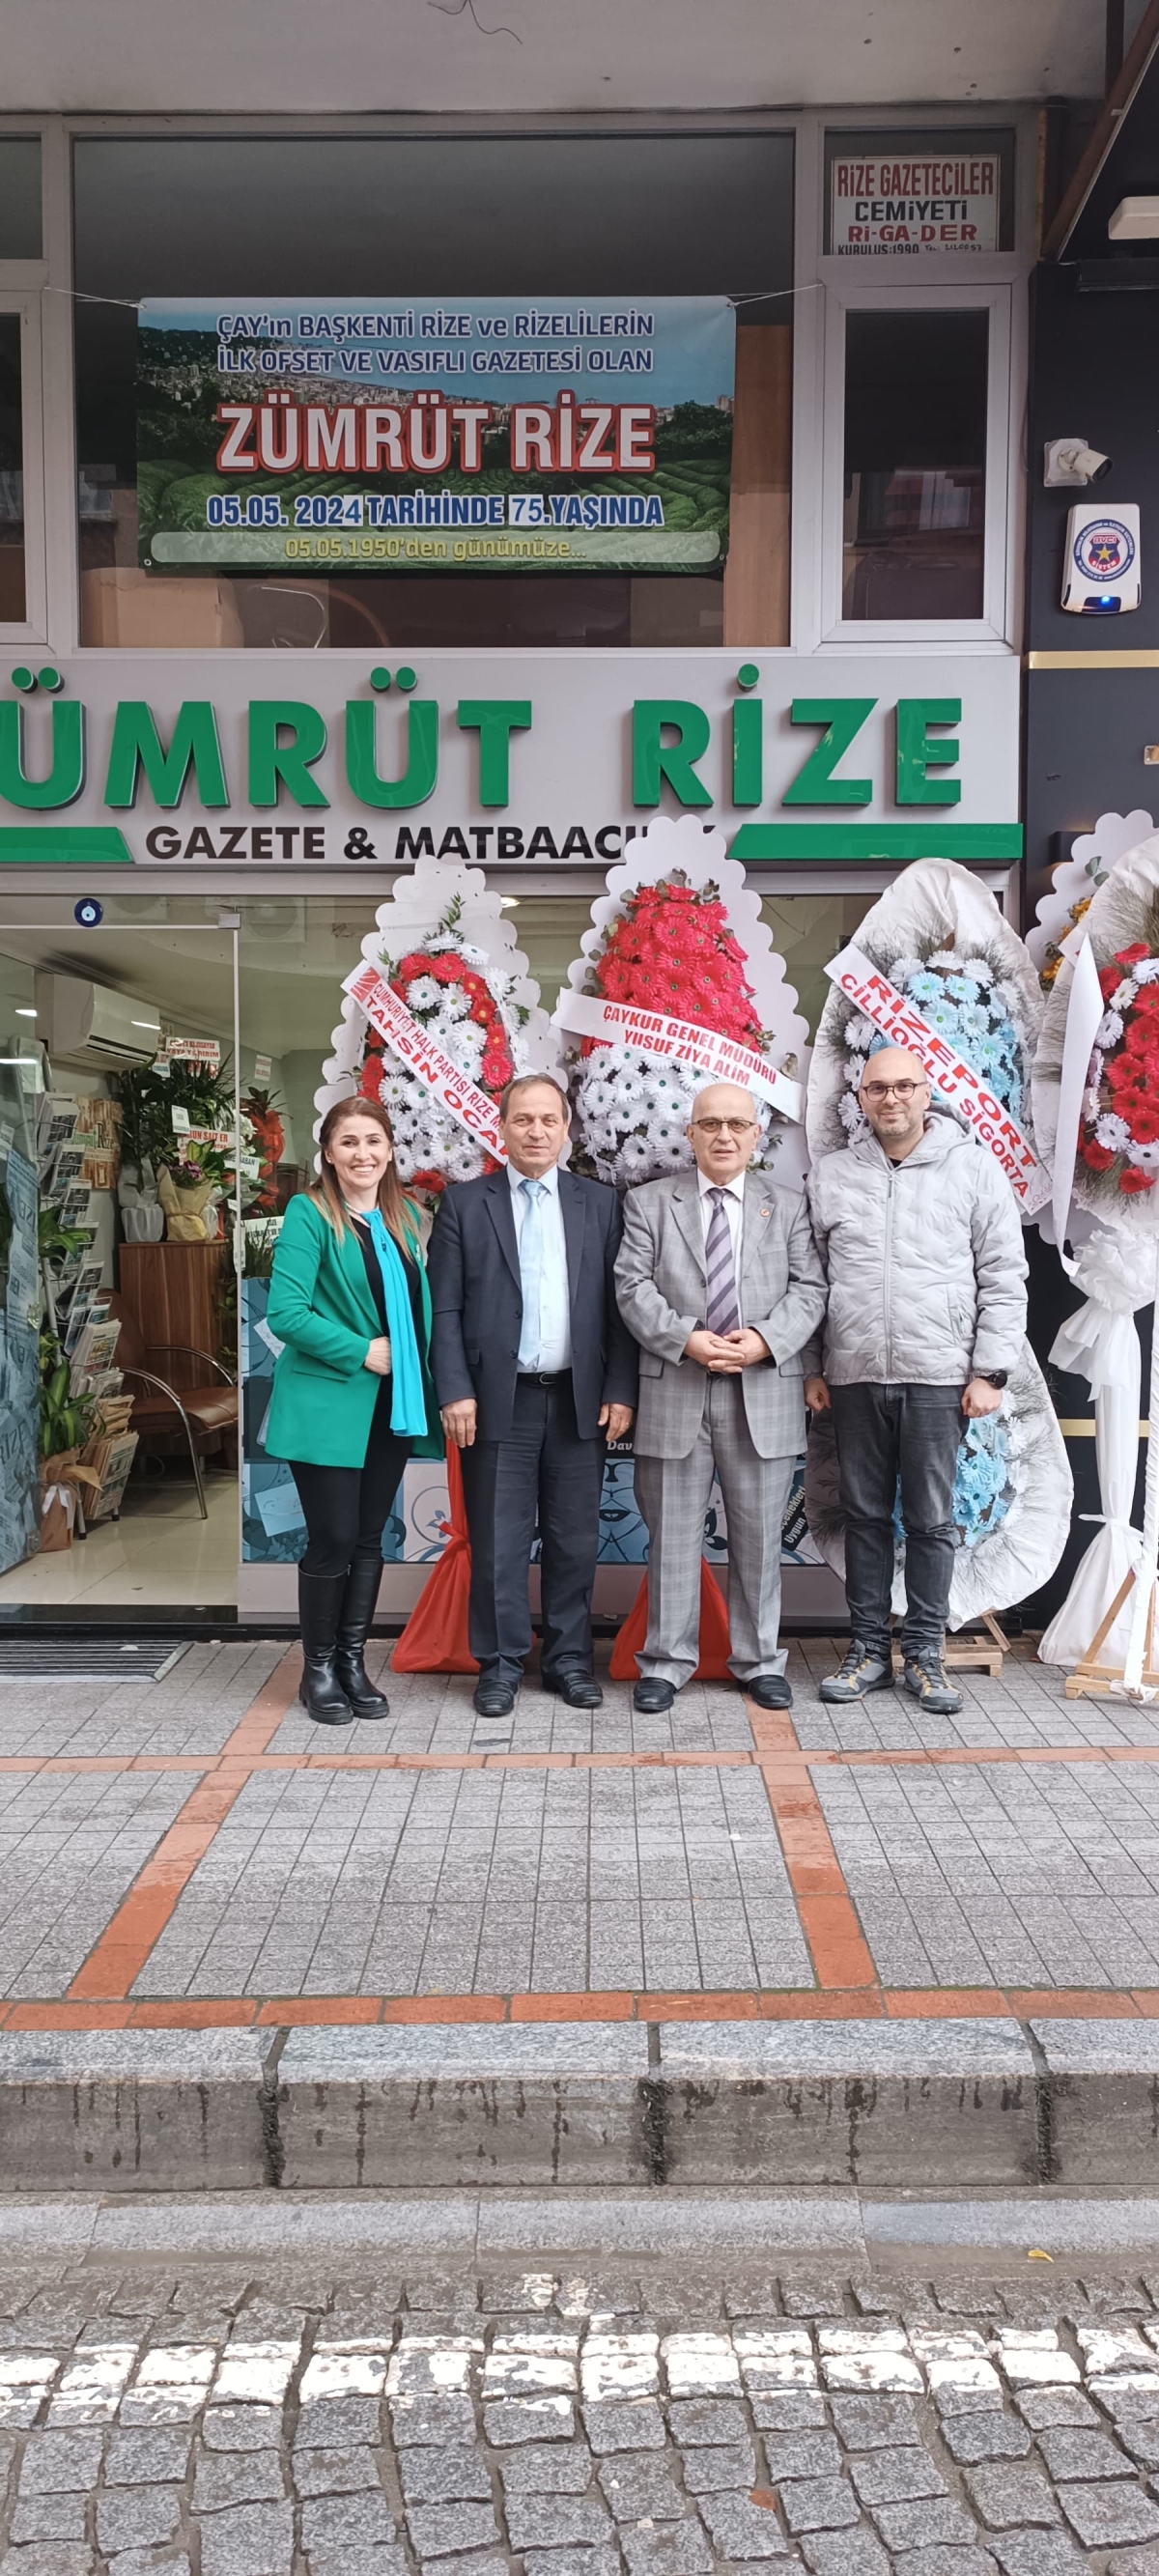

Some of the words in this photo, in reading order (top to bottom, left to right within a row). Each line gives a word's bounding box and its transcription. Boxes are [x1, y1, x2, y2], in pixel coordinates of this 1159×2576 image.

[218, 346, 255, 372] İLK
[262, 352, 334, 372] OFSET
[341, 351, 371, 372] VE
[379, 351, 465, 372] VASIFLI
[472, 346, 581, 372] GAZETESİ
[588, 350, 652, 371] OLAN
[299, 310, 413, 343] BAŞKENTİ
[421, 310, 470, 336] RİZE
[477, 319, 507, 336] ve
[515, 310, 654, 336] RİZELİLERİN
[219, 392, 490, 470] ZÜMRÜT
[513, 391, 653, 469] RİZE
[208, 495, 288, 525] 05.05.
[296, 495, 362, 525] 2024
[367, 490, 504, 525] TARİHİNDE
[633, 664, 963, 808] RİZE
[146, 826, 325, 860] GAZETE
[343, 827, 379, 860] &
[364, 995, 439, 1084] TAHSİN
[373, 982, 416, 1033] CUMHURİYET
[410, 1029, 438, 1060] HALK
[434, 1054, 473, 1096] PARTİSİ
[466, 1089, 495, 1119] RİZE
[603, 1005, 664, 1033] ÇAYKUR
[666, 1022, 716, 1051] GENEL
[720, 1041, 777, 1086] MÜDÜRÜ
[674, 1043, 711, 1068] ZİYA
[712, 1058, 750, 1086] ALİM
[867, 974, 1038, 1169] RİZEPORT
[958, 1096, 1030, 1198] SİGORTA
[783, 1516, 806, 1544] Uygun
